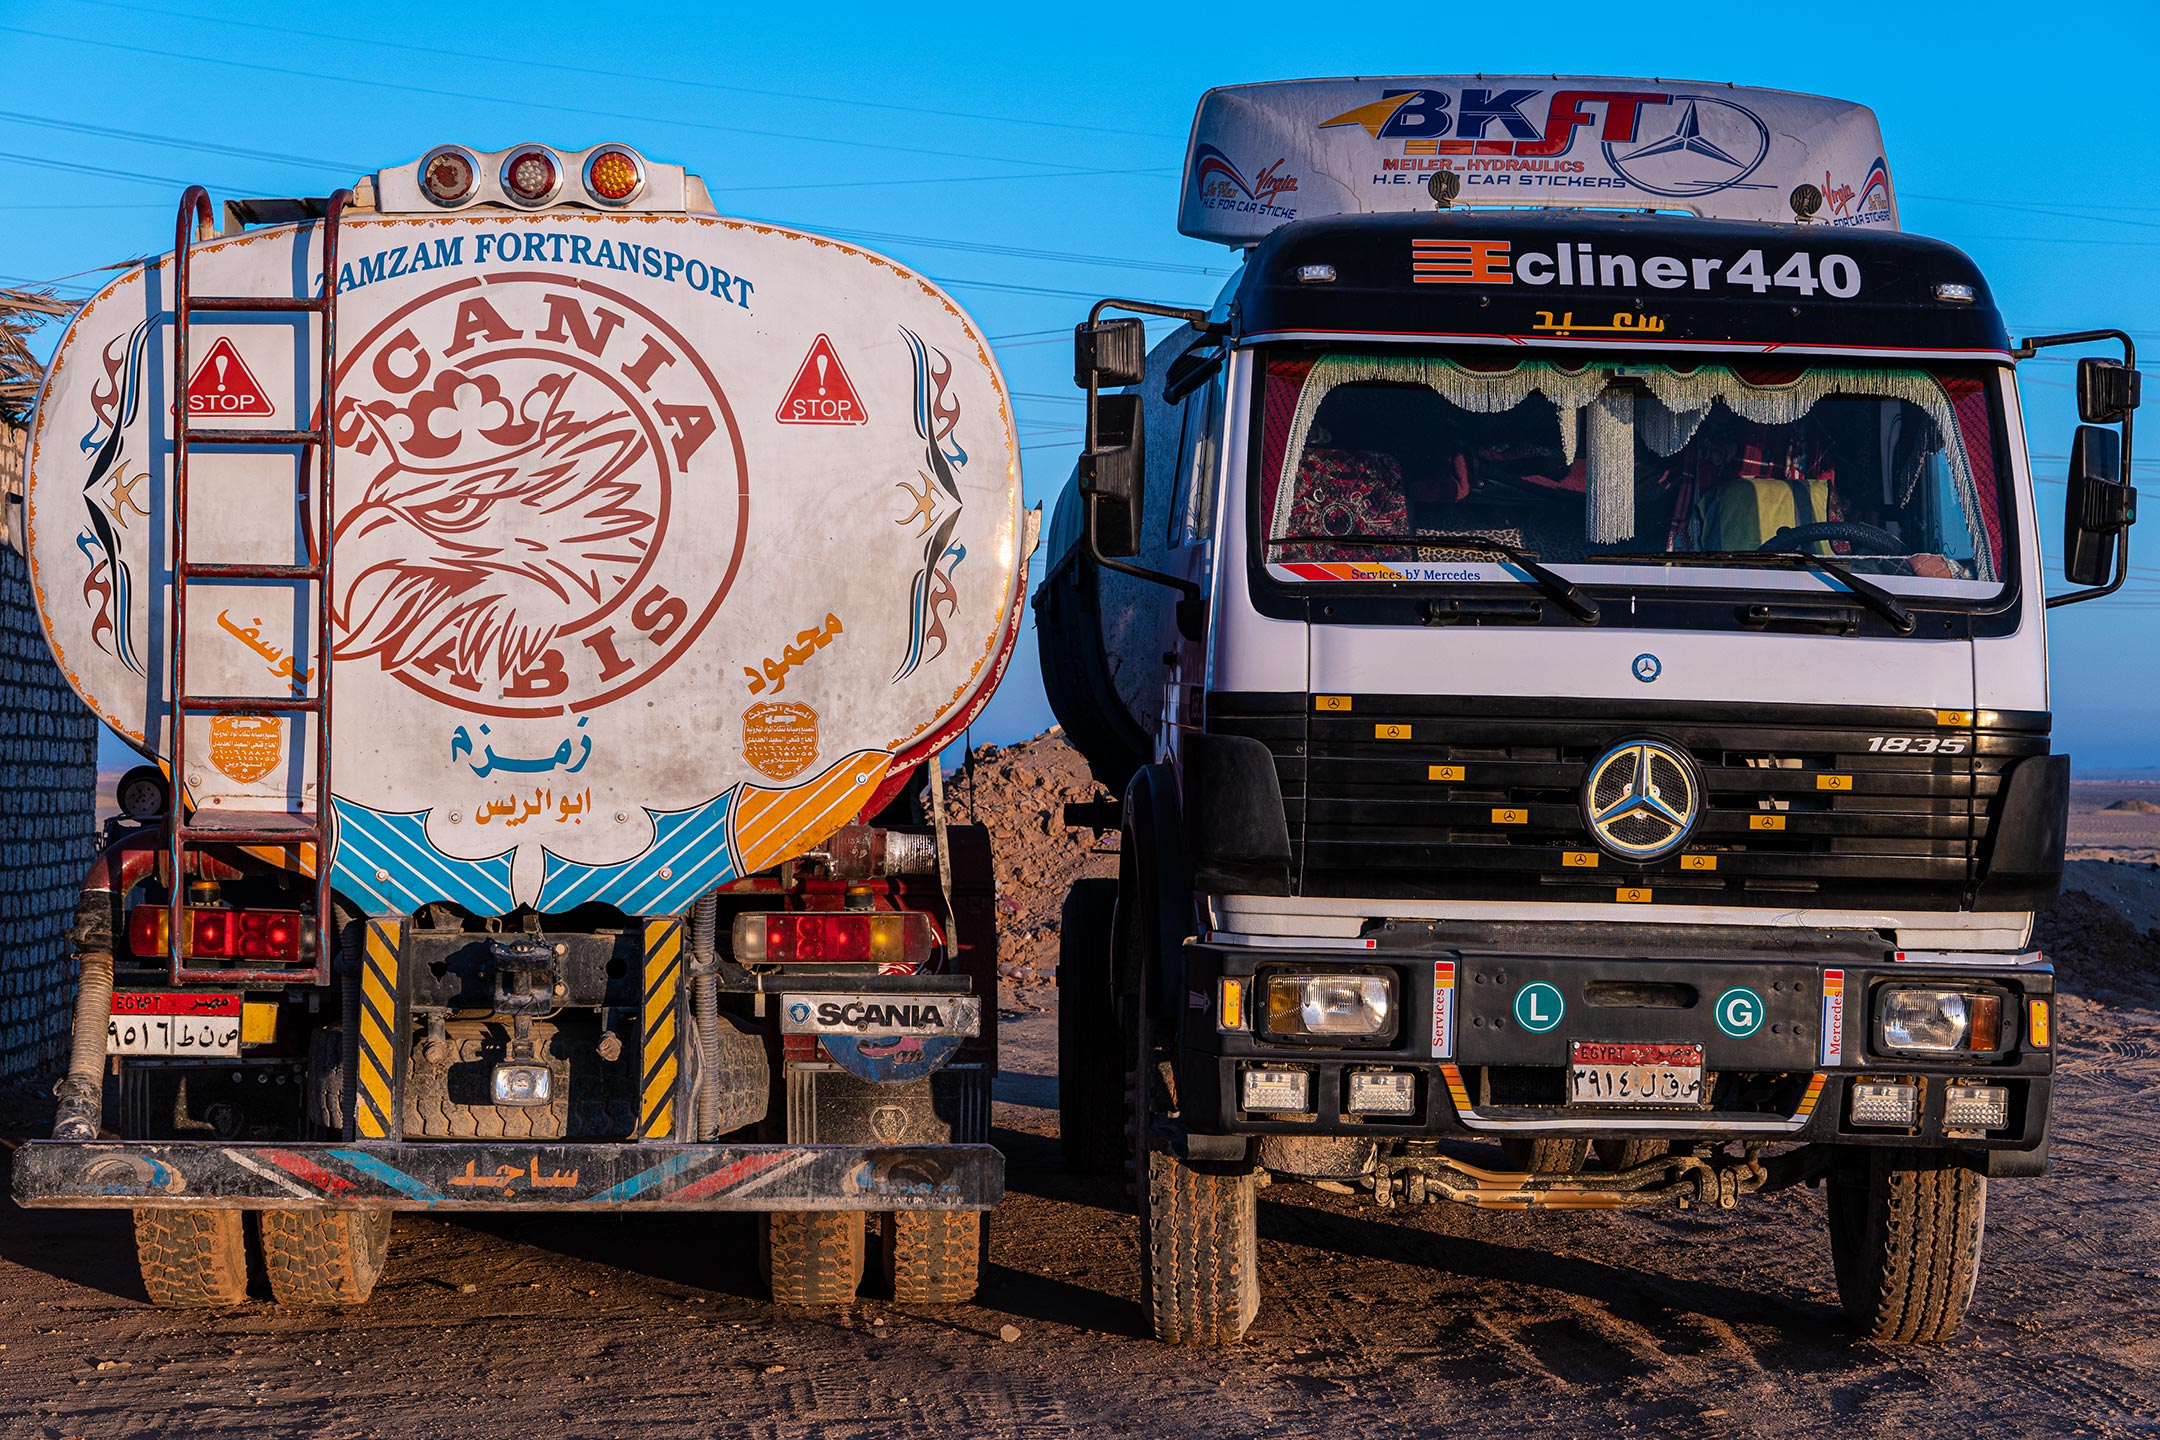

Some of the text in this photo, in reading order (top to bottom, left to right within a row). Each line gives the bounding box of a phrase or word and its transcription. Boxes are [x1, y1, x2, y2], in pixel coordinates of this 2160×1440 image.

[1254, 157, 1298, 208] Virgin
[1467, 174, 1513, 185] CAR
[1517, 175, 1627, 188] STICKERS
[1821, 170, 1856, 220] Virgin
[1216, 199, 1235, 211] FOR
[1236, 202, 1258, 213] CAR
[474, 231, 756, 310] FORTRANSPORT
[1532, 310, 1666, 337] سعيد
[335, 293, 717, 473] SCANIA
[188, 394, 256, 411] STOP
[792, 399, 852, 417] STOP
[1350, 568, 1481, 581] Services by Mercedes
[216, 608, 316, 697] يوسف
[742, 611, 845, 696] محمود
[450, 715, 593, 779] زمزم
[1867, 736, 1968, 754] 1835
[475, 786, 593, 828] ابو الريس
[116, 995, 162, 1011] EGYPT
[188, 996, 230, 1012] مصر
[816, 1002, 945, 1028] SCANIA
[1432, 988, 1446, 1048] Services
[1529, 992, 1549, 1022] L
[1726, 997, 1754, 1028] G
[107, 1020, 170, 1050] ٩٥١٦
[1828, 990, 1843, 1056] Mercedes
[1581, 1046, 1626, 1061] EGYPT
[1572, 1069, 1633, 1098] ٣٩١٤
[447, 1154, 579, 1198] ساجد
